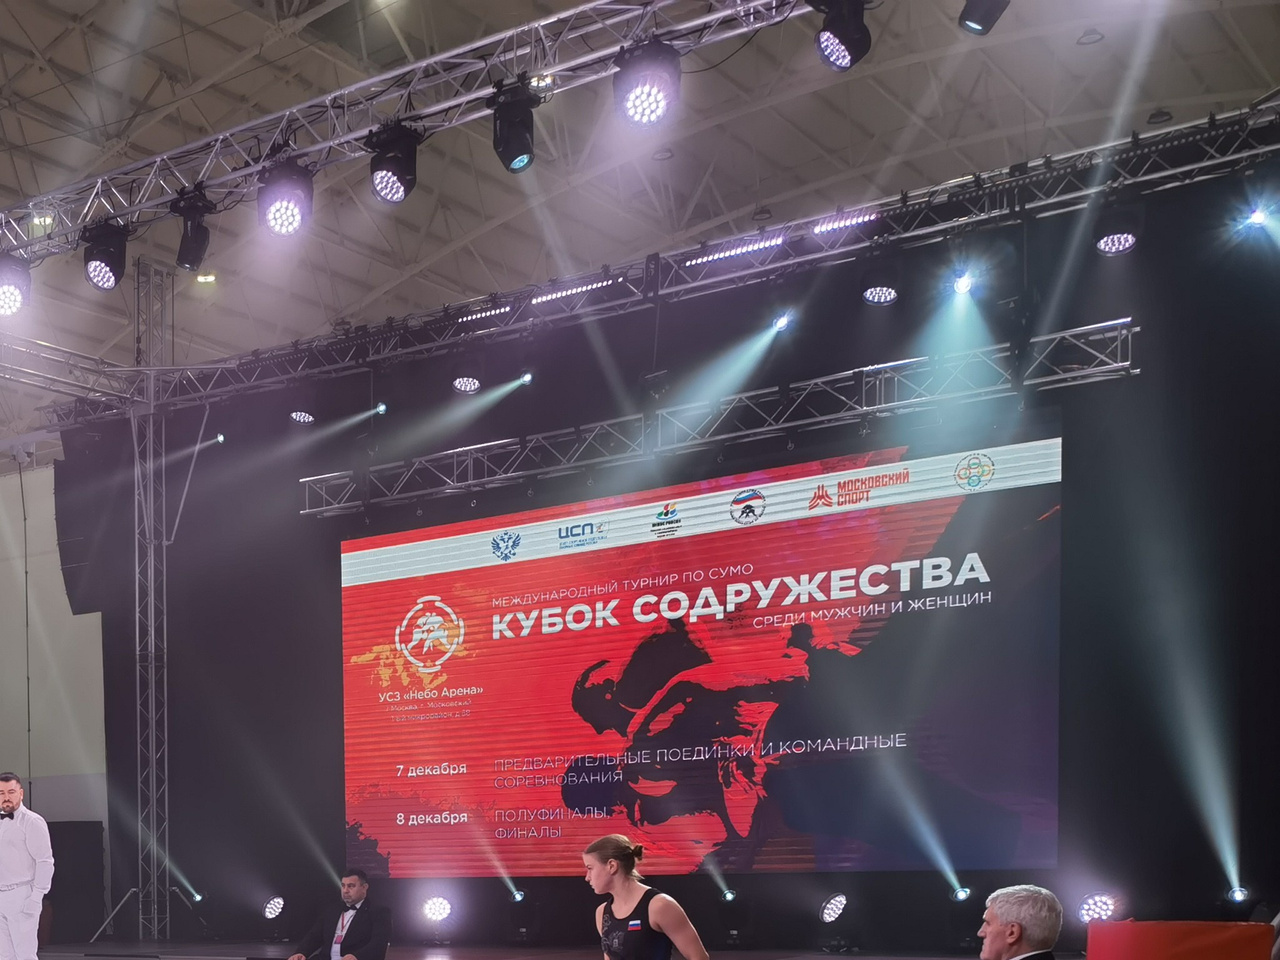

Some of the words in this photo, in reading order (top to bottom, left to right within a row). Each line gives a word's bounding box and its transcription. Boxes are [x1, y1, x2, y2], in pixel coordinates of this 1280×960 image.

[837, 467, 910, 493] МОСКОВСКИЙ
[837, 491, 871, 507] СПОРТ
[558, 522, 594, 539] ЦСП
[492, 580, 618, 608] МЕЖДУНАРОДНЫЙ
[622, 573, 680, 592] ТУРНИР
[682, 570, 705, 583] ПО
[708, 563, 754, 581] СУМО
[492, 598, 620, 640] КУБОК
[632, 552, 991, 624] СОДРУЖЕСТВА
[753, 613, 806, 629] СРЕДИ
[810, 602, 886, 624] МУЖЧИН
[891, 601, 903, 614] И
[908, 591, 992, 612] ЖЕНЩИН
[378, 692, 401, 703] УСЗ
[403, 689, 438, 701] «Небо
[440, 686, 484, 699] Арена»
[494, 750, 651, 772] ПРЕДВАРИТЕЛЬНЫЕ
[656, 743, 756, 762] ПОЕДИНКИ
[761, 742, 773, 755] И
[779, 733, 907, 753] КОМАНДНЫЕ
[396, 765, 404, 777] 7
[407, 763, 467, 777] декабря
[494, 770, 624, 789] СОРЕВНОВАНИЯ
[396, 813, 405, 825] 8
[408, 811, 468, 825] декабря
[494, 826, 563, 840] ФИНАЛЫ
